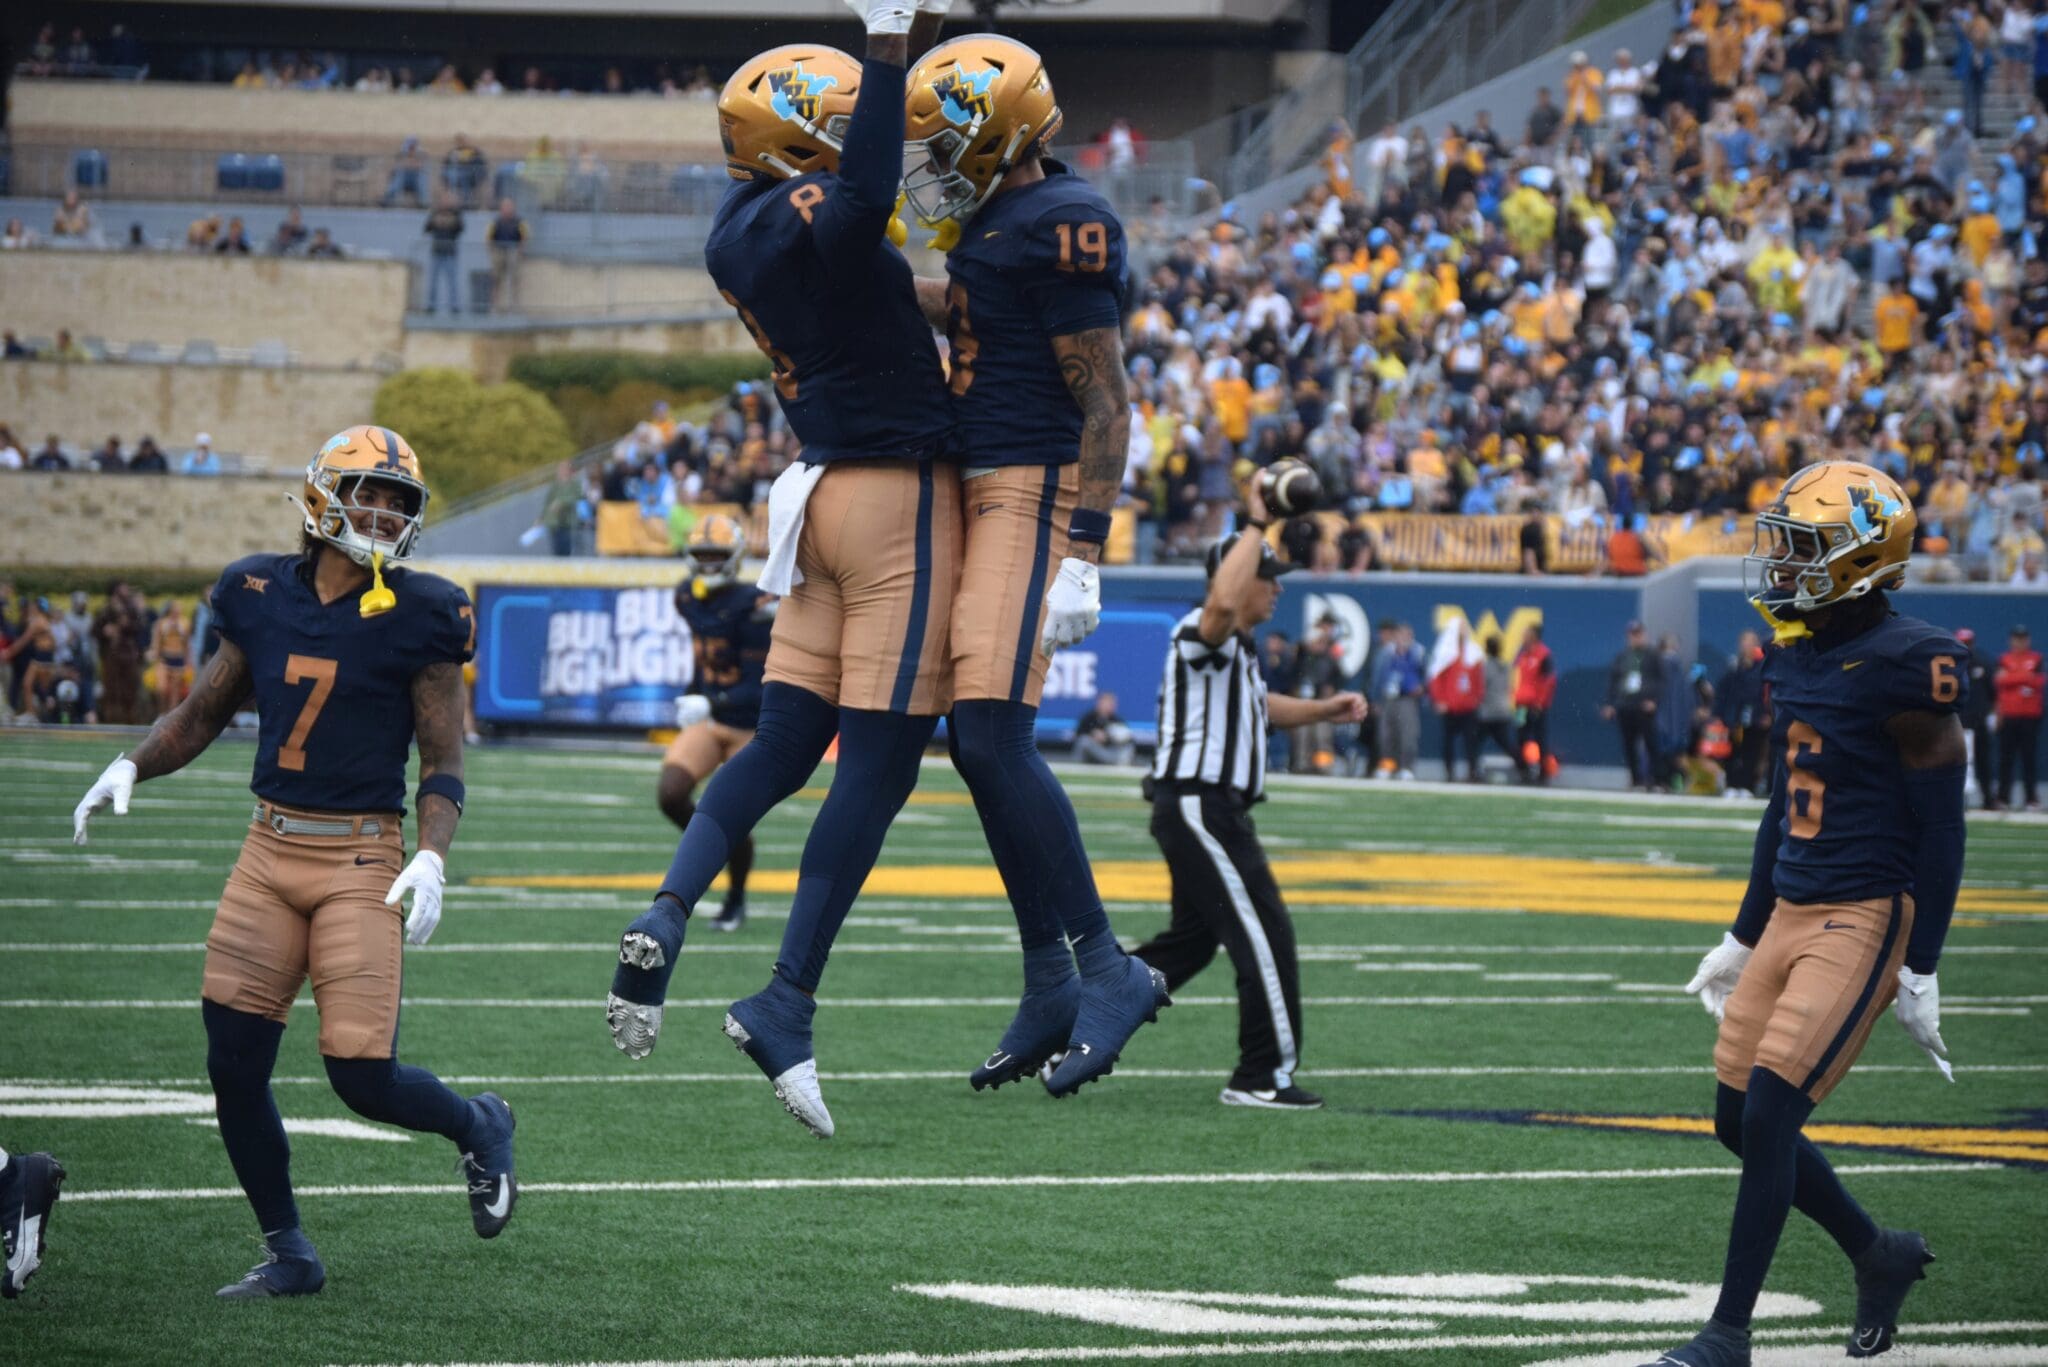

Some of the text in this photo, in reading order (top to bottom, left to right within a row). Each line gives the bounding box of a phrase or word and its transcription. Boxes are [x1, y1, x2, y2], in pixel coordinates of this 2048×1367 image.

[768, 67, 820, 121] WVU
[931, 71, 992, 122] WVU
[1055, 222, 1108, 273] 19
[1930, 655, 1959, 703] 6
[278, 653, 339, 771] 7
[1786, 719, 1827, 840] 6
